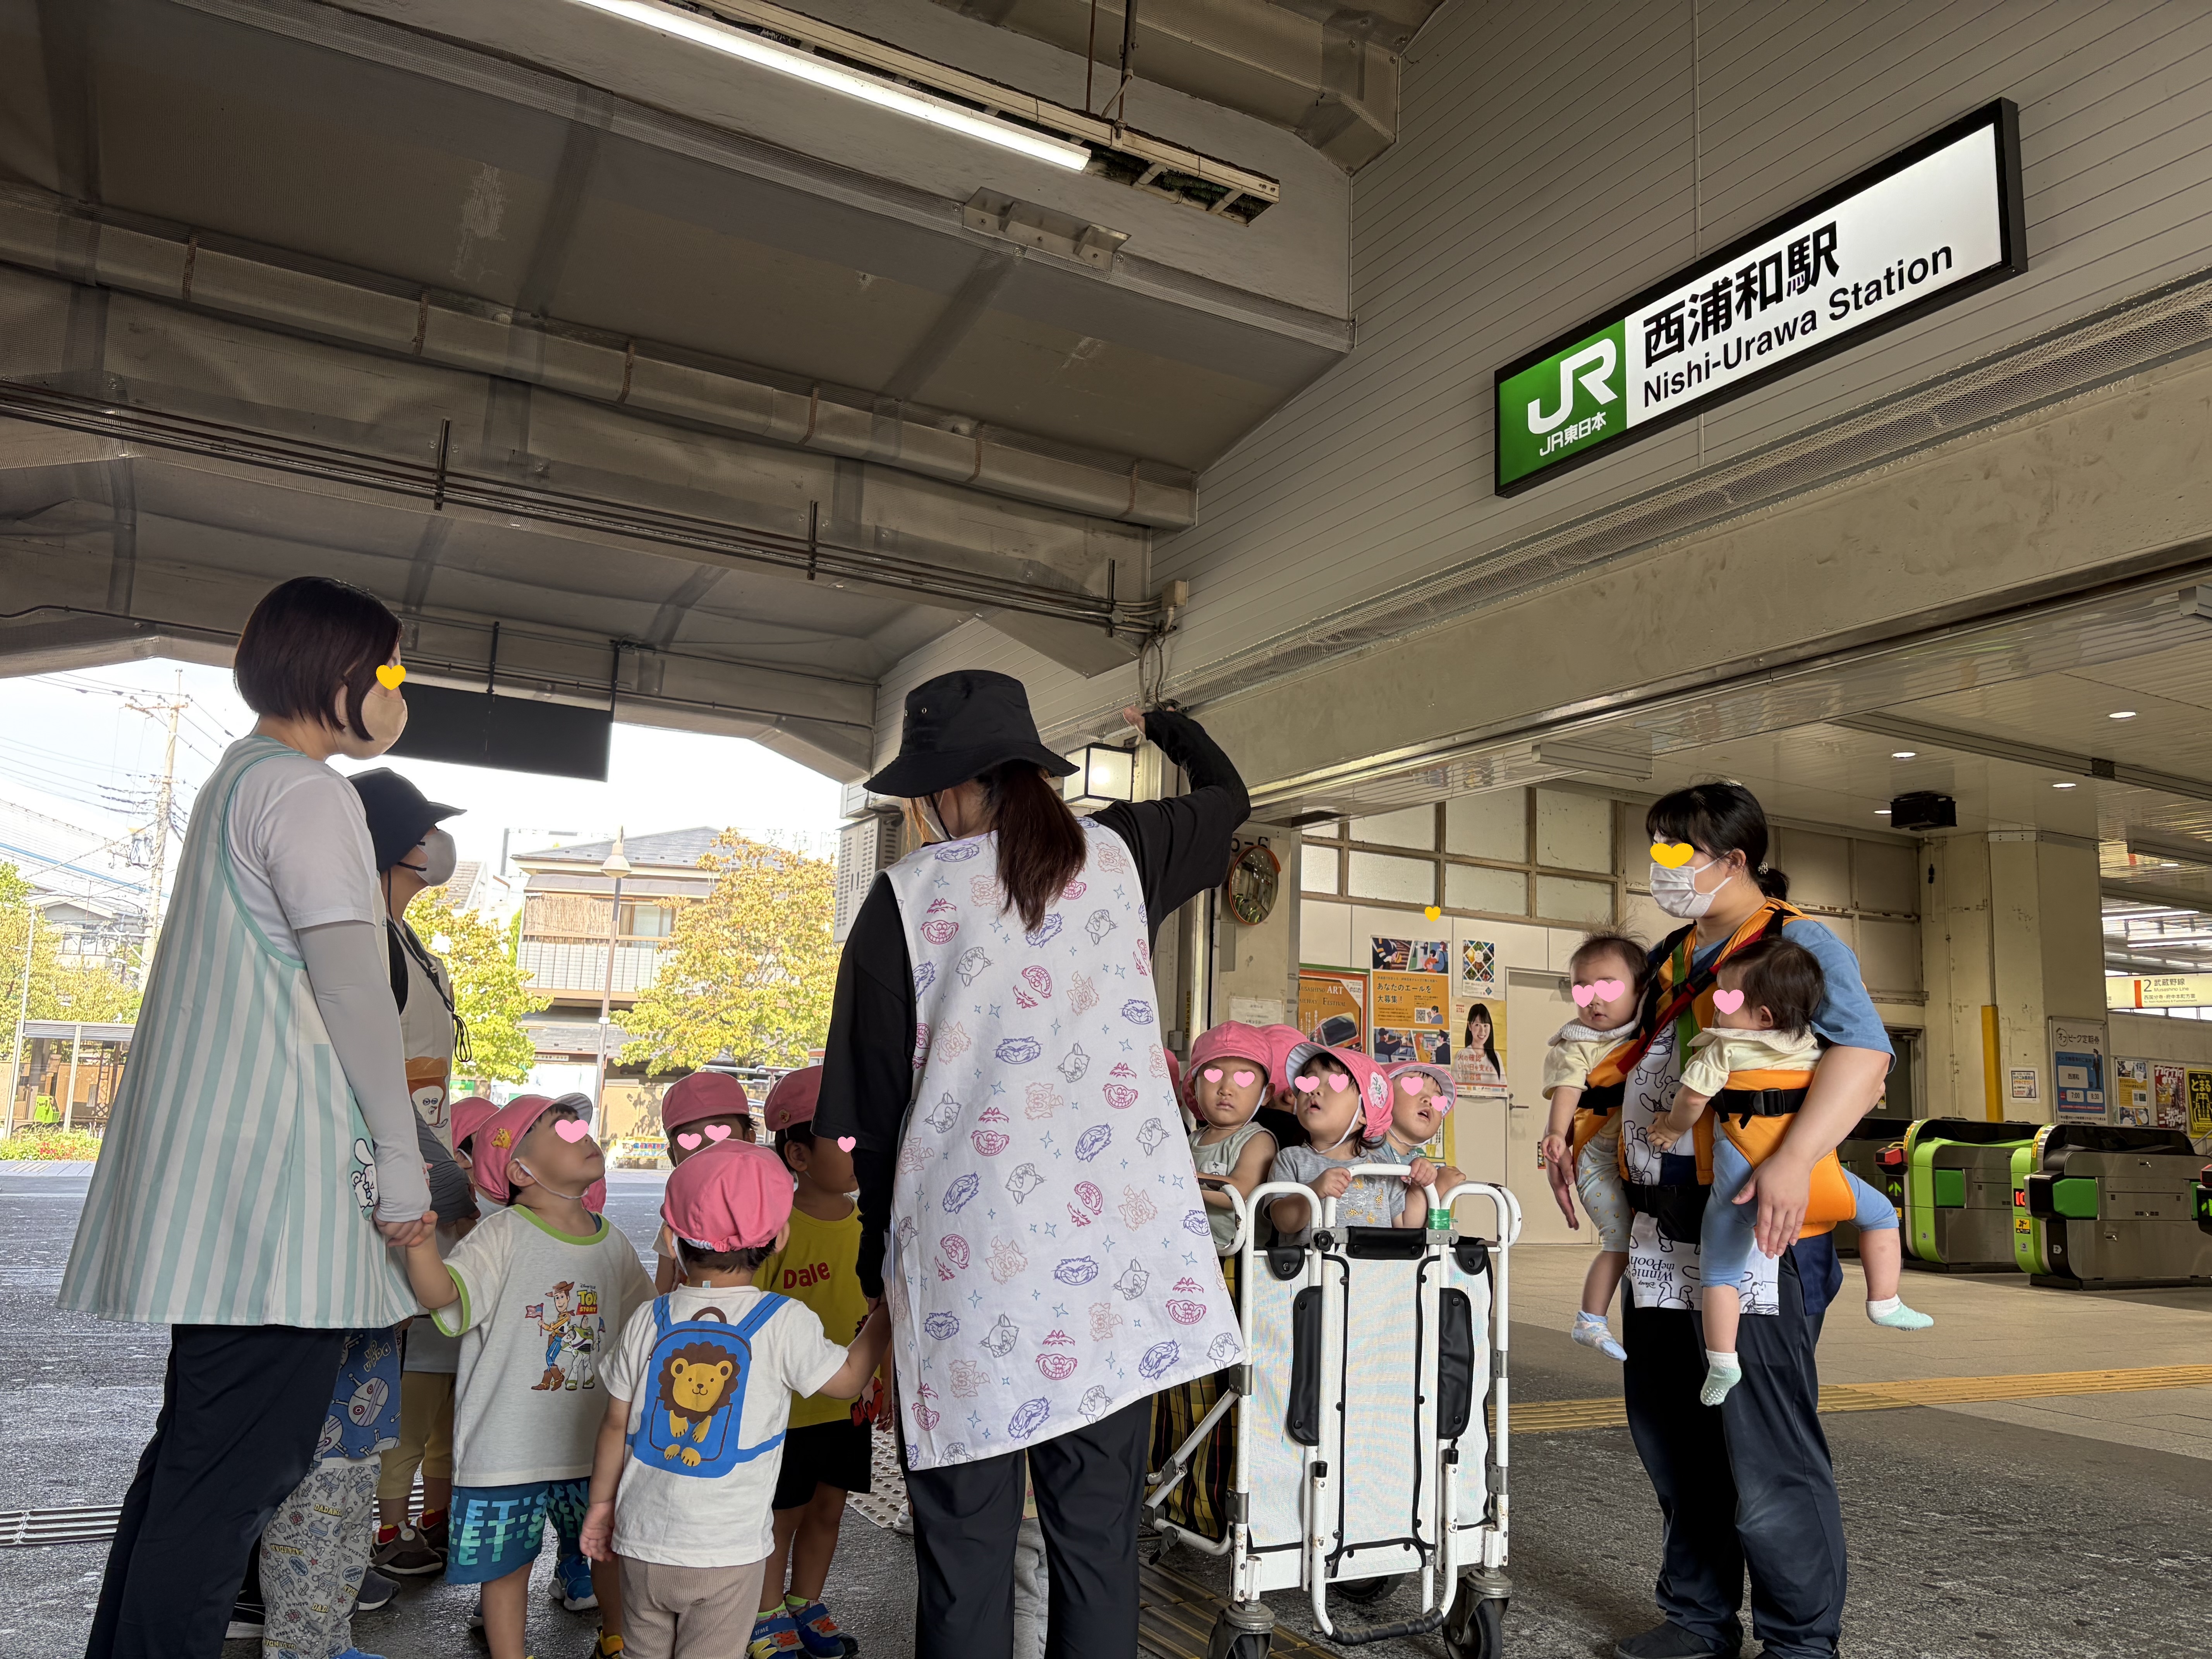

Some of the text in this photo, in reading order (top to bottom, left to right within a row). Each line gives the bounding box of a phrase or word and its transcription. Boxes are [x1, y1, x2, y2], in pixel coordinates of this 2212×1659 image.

[1643, 221, 1840, 369] 西浦和駅
[1644, 245, 1953, 408] Nishi-Urawa Station
[1527, 337, 1618, 434] JR
[1539, 412, 1607, 456] JR東日本
[1326, 985, 1344, 994] ART
[1377, 982, 1431, 993] あなたのエールを
[2143, 979, 2152, 992] 2
[1457, 1054, 1482, 1062] 火の確認
[2191, 1079, 2211, 1092] とまる
[783, 1262, 831, 1289] Dale
[1631, 1268, 1673, 1281] Winnie
[1638, 1280, 1656, 1289] Disney
[577, 1290, 597, 1306] TOY
[755, 1626, 769, 1635] IFME
